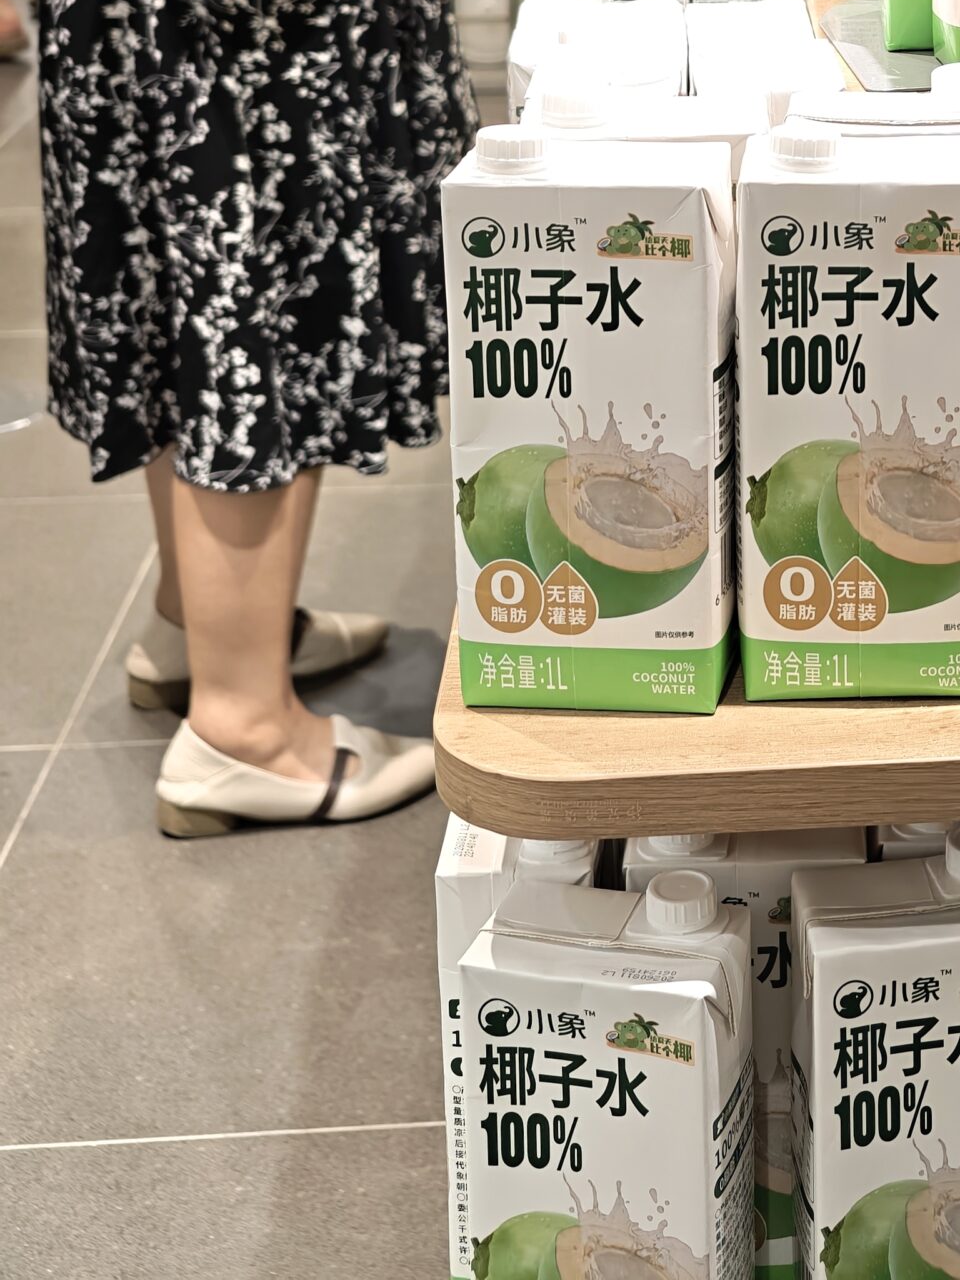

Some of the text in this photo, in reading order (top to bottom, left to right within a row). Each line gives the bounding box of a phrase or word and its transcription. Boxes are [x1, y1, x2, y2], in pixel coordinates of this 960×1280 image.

[512, 223, 576, 252] 小象
[810, 221, 874, 250] 小象
[463, 266, 644, 333] 椰子水
[761, 262, 939, 330] 椰子水
[465, 338, 572, 399] 100%
[761, 333, 866, 395] 100%
[491, 570, 525, 604] 0
[547, 585, 585, 604] 无菌
[780, 566, 815, 602] 0
[837, 580, 876, 599] 无菌
[491, 607, 527, 624] 脂肪
[548, 607, 587, 626] 灌装
[779, 604, 816, 620] 脂肪
[837, 603, 876, 622] 灌装
[655, 631, 694, 639] 图片仅供参考
[478, 652, 568, 690] 净含量:1L
[633, 673, 695, 684] COCONUT
[661, 662, 695, 672] 100%
[764, 650, 853, 687] 净含量:1L
[652, 684, 695, 695] WATER
[879, 977, 940, 1007] 小象
[526, 1009, 586, 1040] 小象
[479, 1044, 649, 1117] 椰子水
[834, 1080, 932, 1151] 100%
[481, 1111, 582, 1172] 100%
